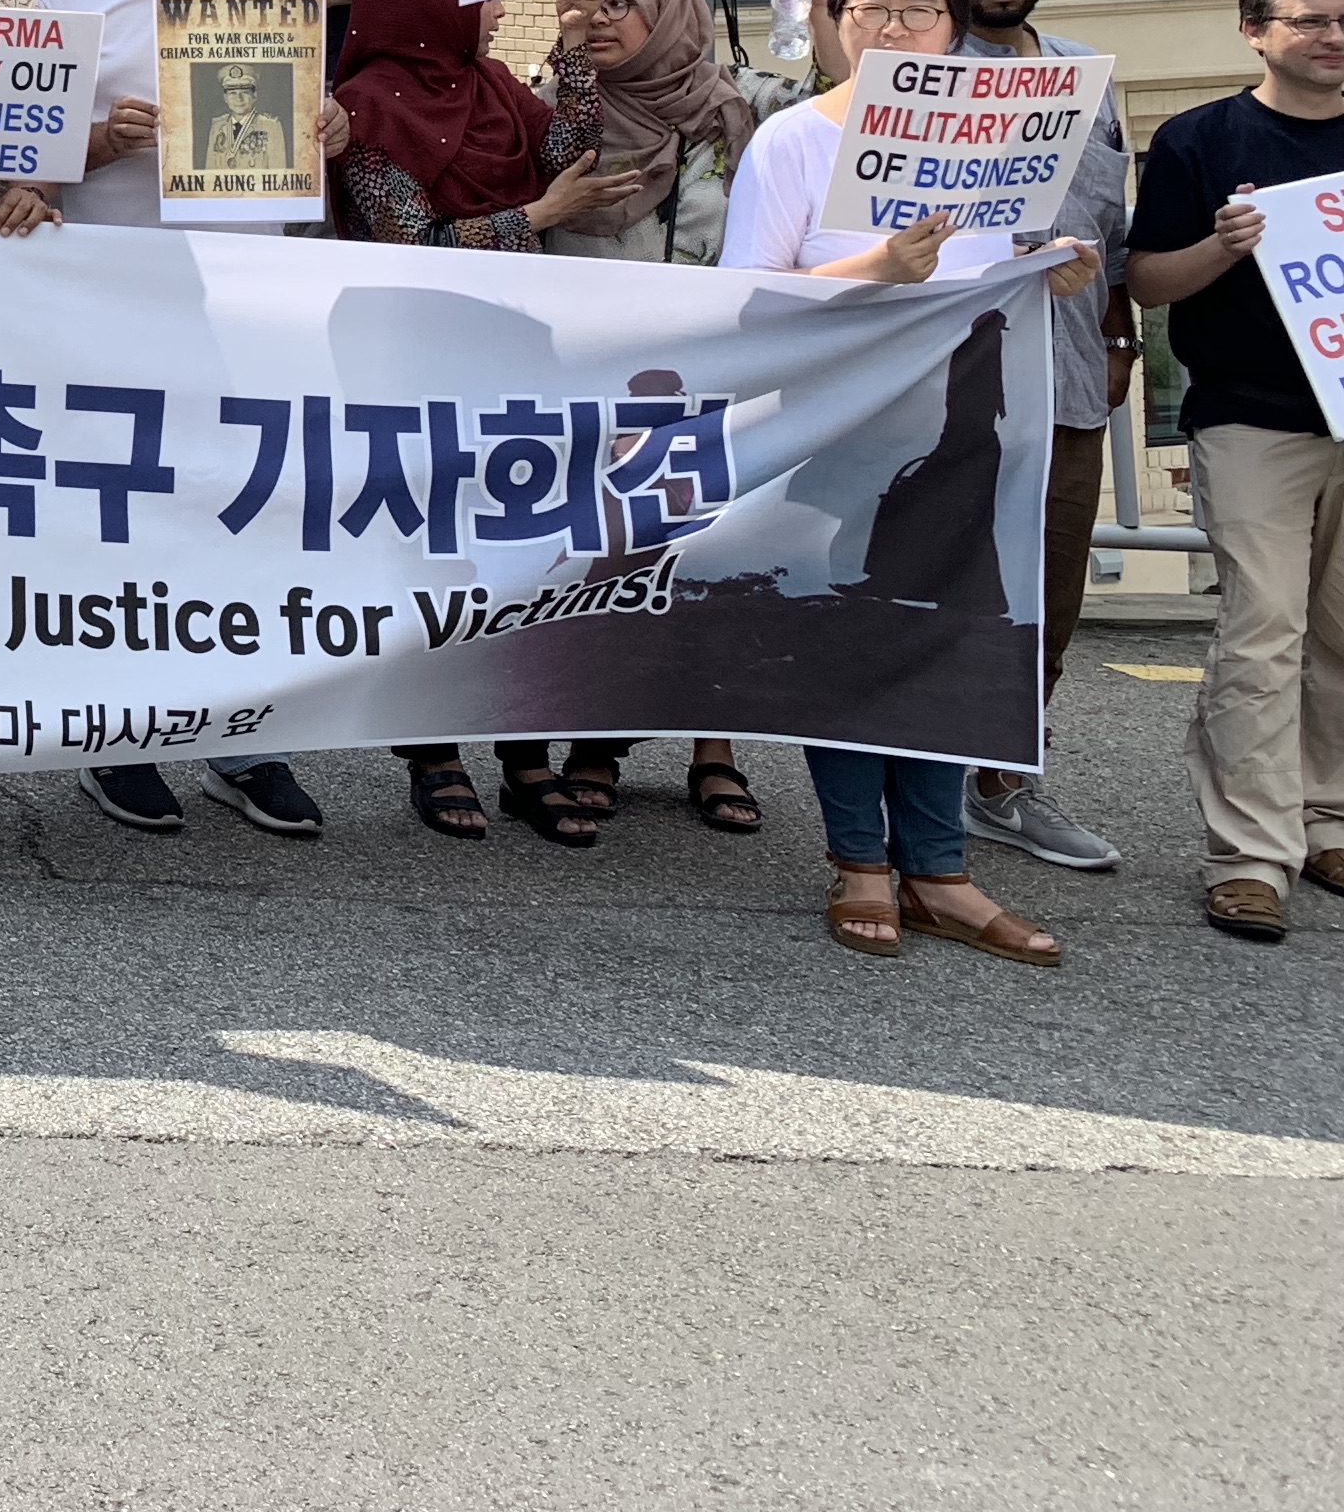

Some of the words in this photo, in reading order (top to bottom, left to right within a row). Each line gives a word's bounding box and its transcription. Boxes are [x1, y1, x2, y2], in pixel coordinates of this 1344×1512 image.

[160, 47, 204, 59] CRIMES
[208, 47, 258, 59] AGAINST
[262, 47, 316, 59] HUMANITY
[188, 33, 210, 44] FOR
[214, 33, 241, 44] WAR
[245, 33, 285, 44] CRIMES
[287, 33, 294, 43] &
[11, 61, 77, 93] OUT
[892, 61, 967, 97] GET
[971, 65, 1077, 100] BURMA
[860, 104, 1017, 145] MILITARY
[1021, 110, 1081, 142] OUT
[169, 174, 205, 192] MIN
[212, 174, 256, 192] AUNG
[262, 173, 312, 191] HLAING
[855, 150, 908, 183] OF
[914, 153, 1060, 190] BUSINESS
[870, 195, 1026, 231] VENTURES
[1315, 189, 1344, 232] S
[1309, 313, 1344, 359] G
[217, 392, 733, 554] 기자회견
[4, 572, 261, 655] Justice
[279, 586, 393, 659] for
[417, 552, 677, 652] Victims!
[59, 702, 213, 755] 대사관
[224, 702, 275, 740] 앞
